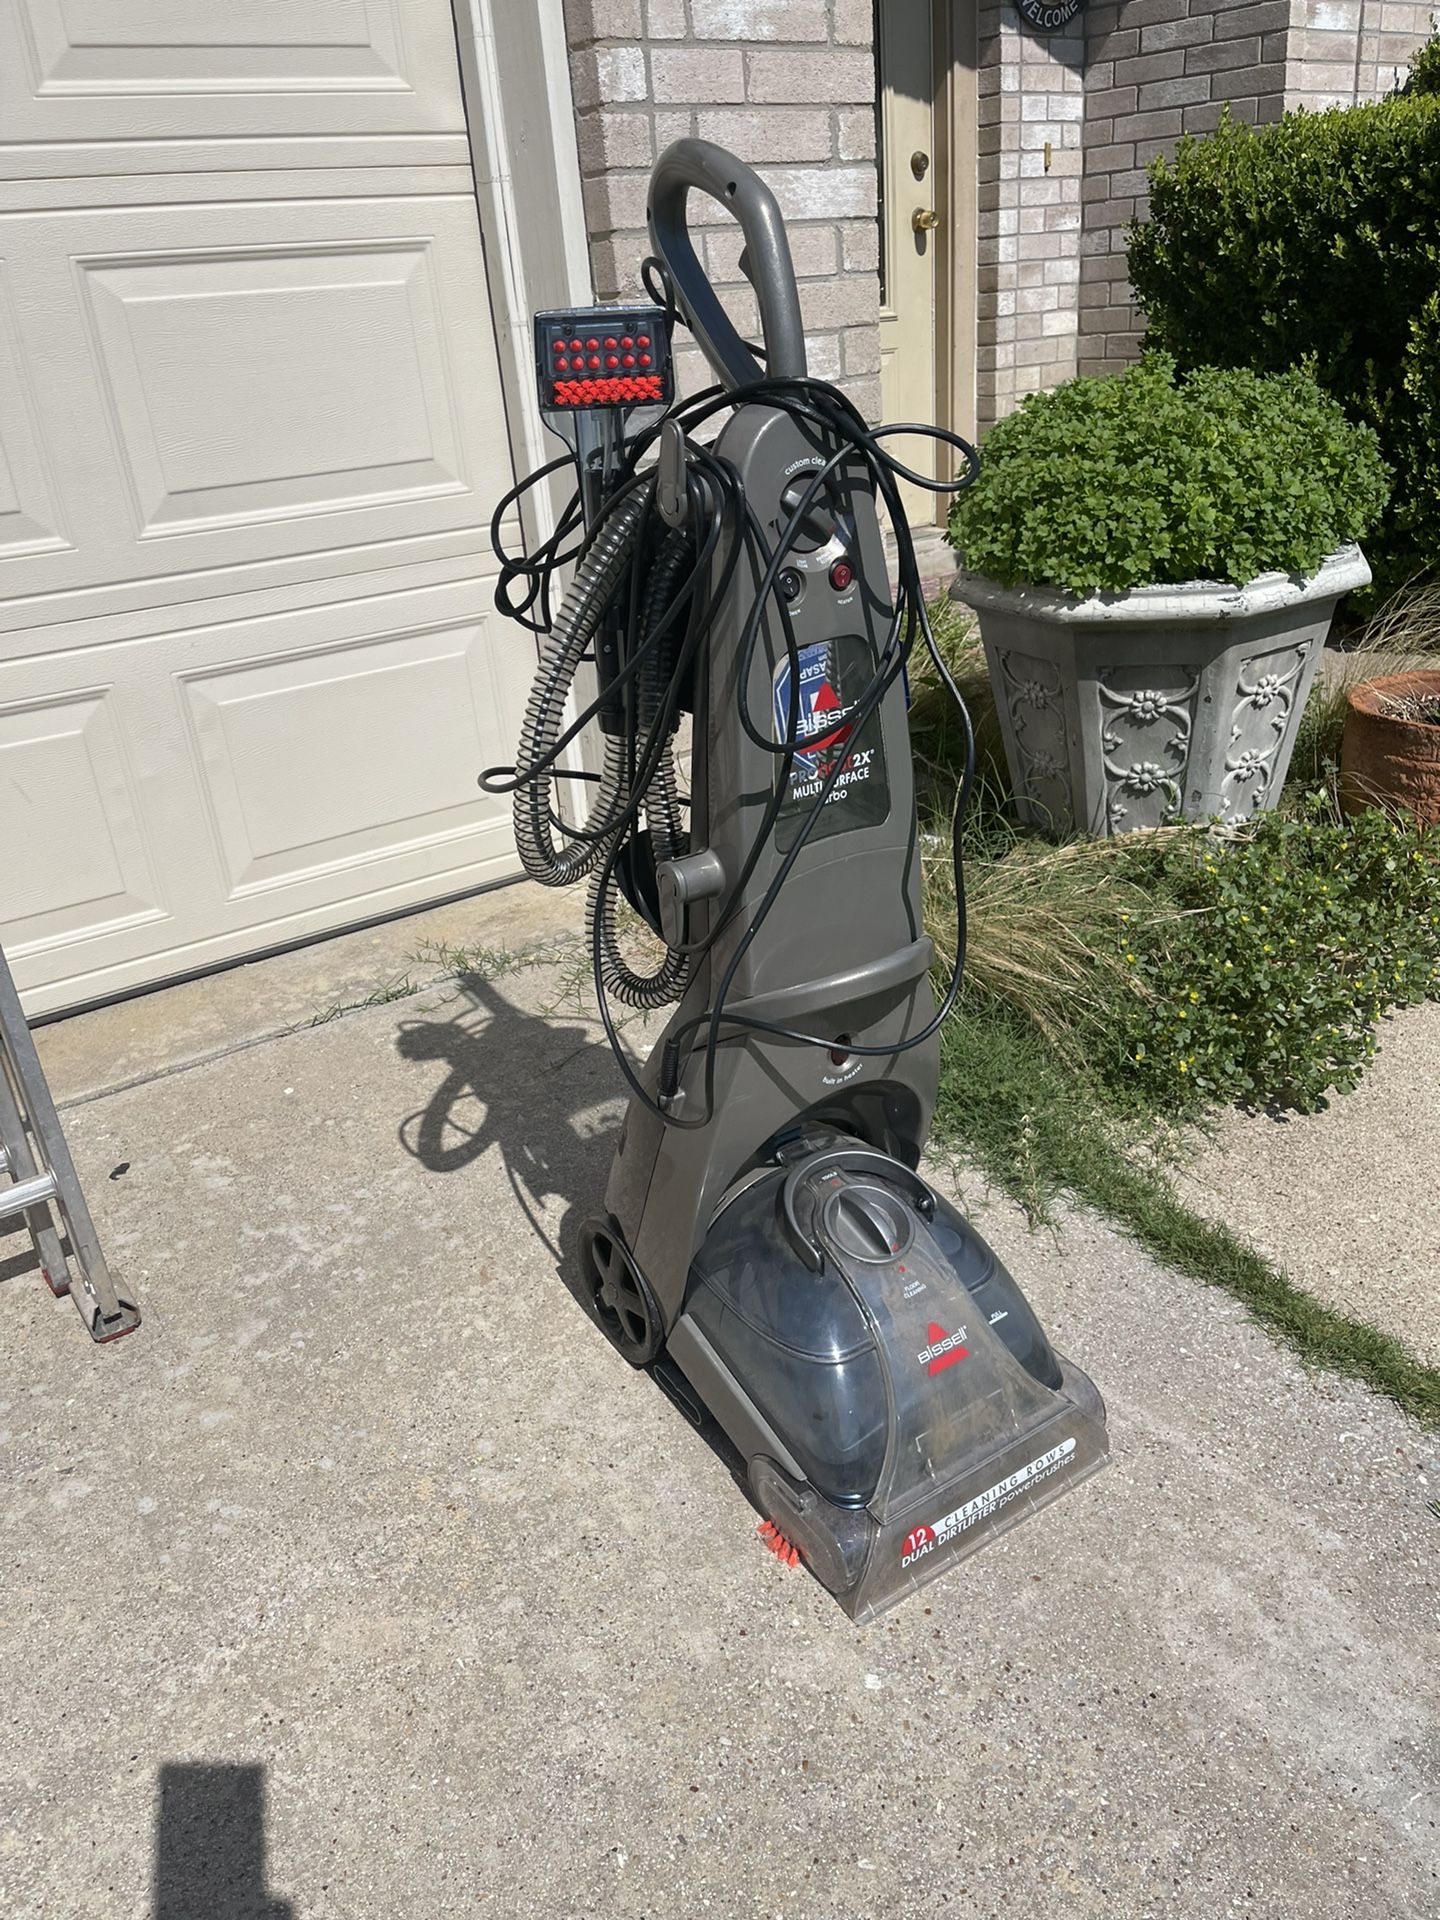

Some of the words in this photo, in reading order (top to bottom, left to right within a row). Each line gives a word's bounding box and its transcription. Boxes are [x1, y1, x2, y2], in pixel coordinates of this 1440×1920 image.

[811, 456, 827, 467] clea
[799, 660, 827, 680] ASAP
[833, 766, 870, 788] URFACE
[825, 789, 848, 804] rbo
[908, 1528, 928, 1551] 12
[944, 1476, 1019, 1528] CLEANING
[1026, 1445, 1065, 1477] ROWS
[901, 1540, 935, 1568] DUAL
[937, 1501, 997, 1546] DIRTLIFTER
[999, 1451, 1076, 1509] powerbrushes
